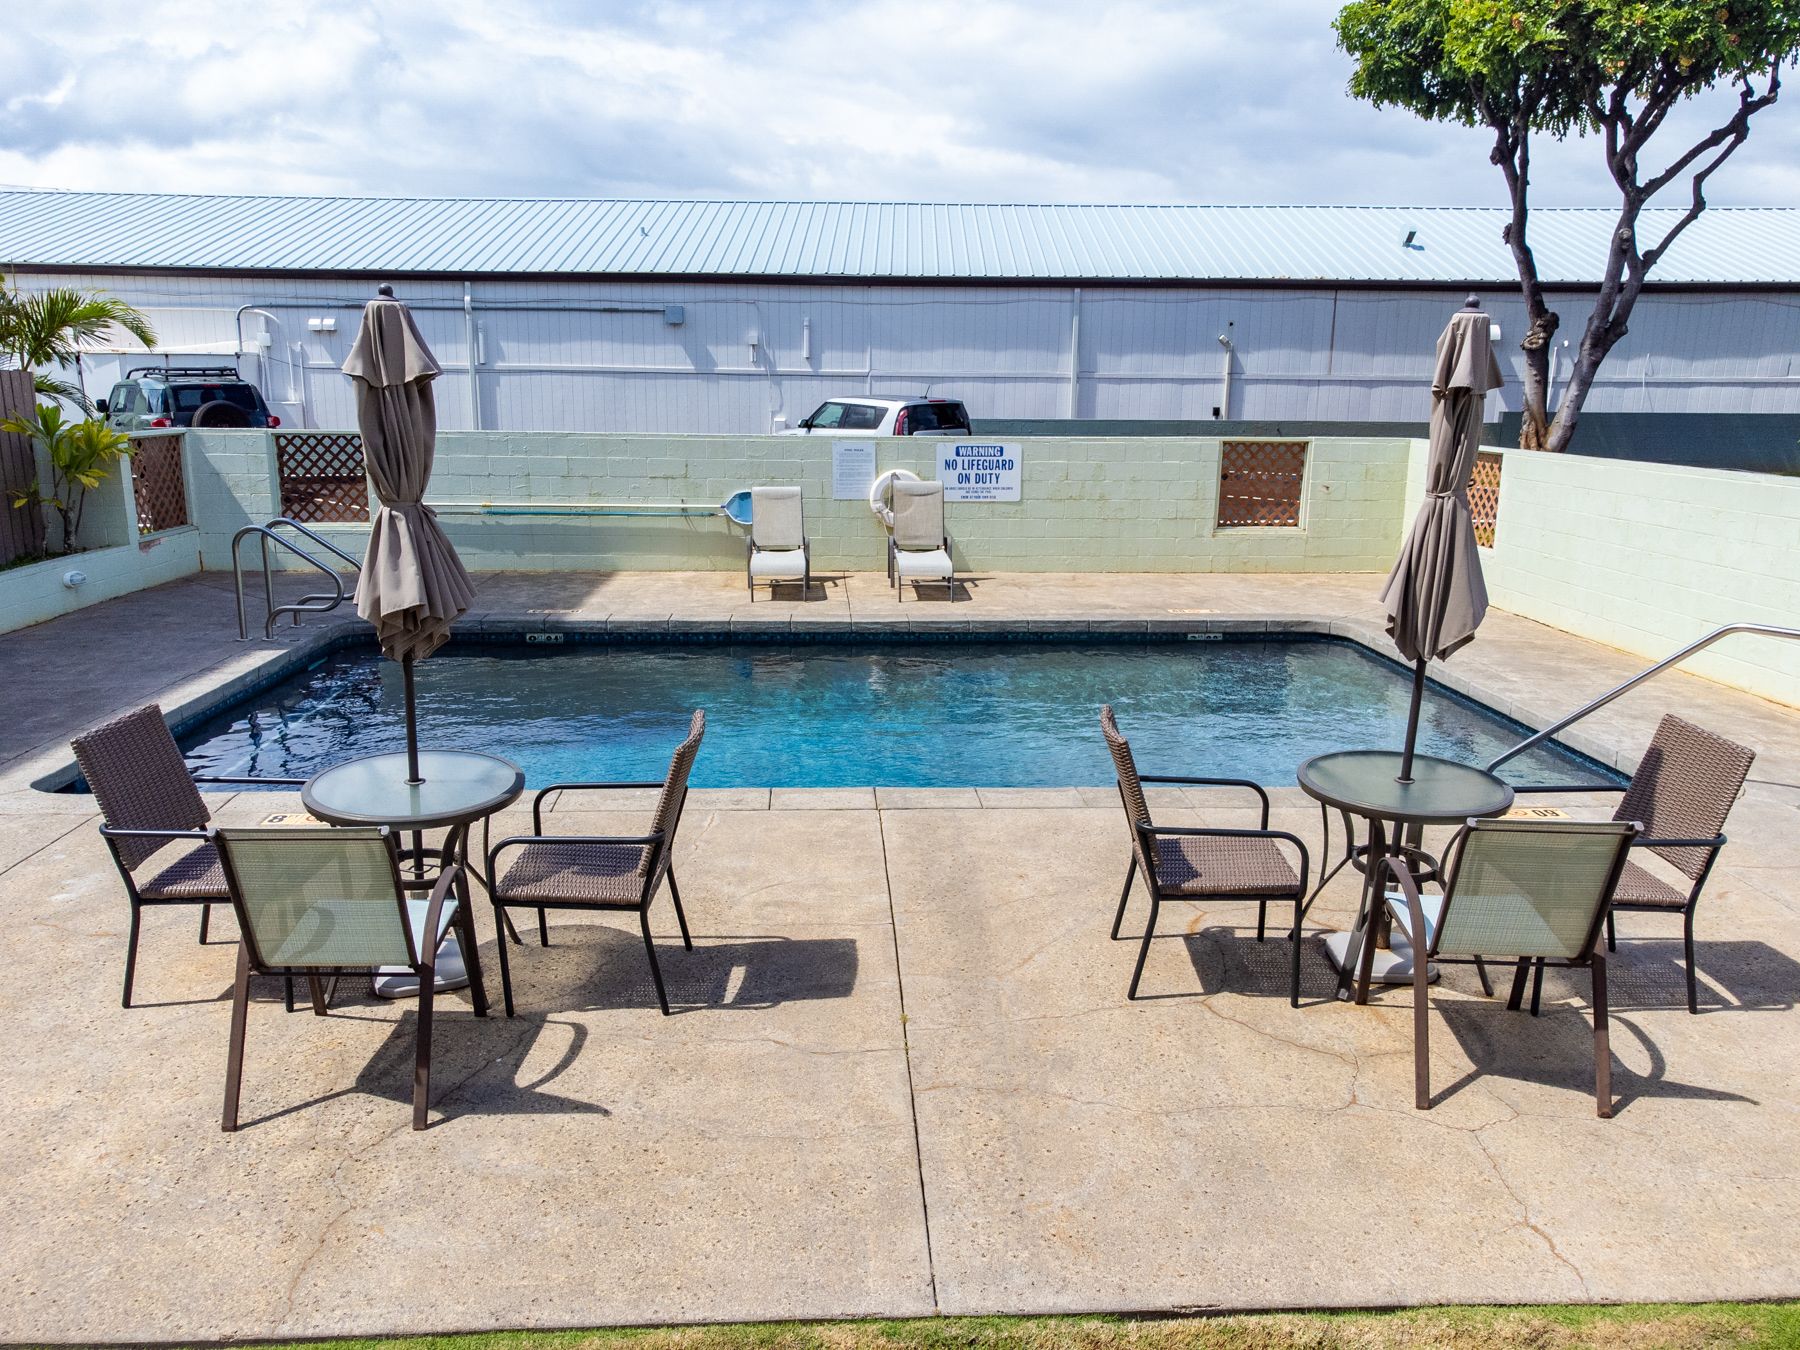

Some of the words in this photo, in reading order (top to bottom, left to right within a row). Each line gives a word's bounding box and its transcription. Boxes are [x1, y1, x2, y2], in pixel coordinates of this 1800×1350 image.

[959, 446, 1001, 456] WARNING
[944, 459, 958, 471] NO
[962, 459, 1014, 471] LIFEGUARD
[957, 472, 971, 484] ON
[974, 472, 1001, 484] DUTY
